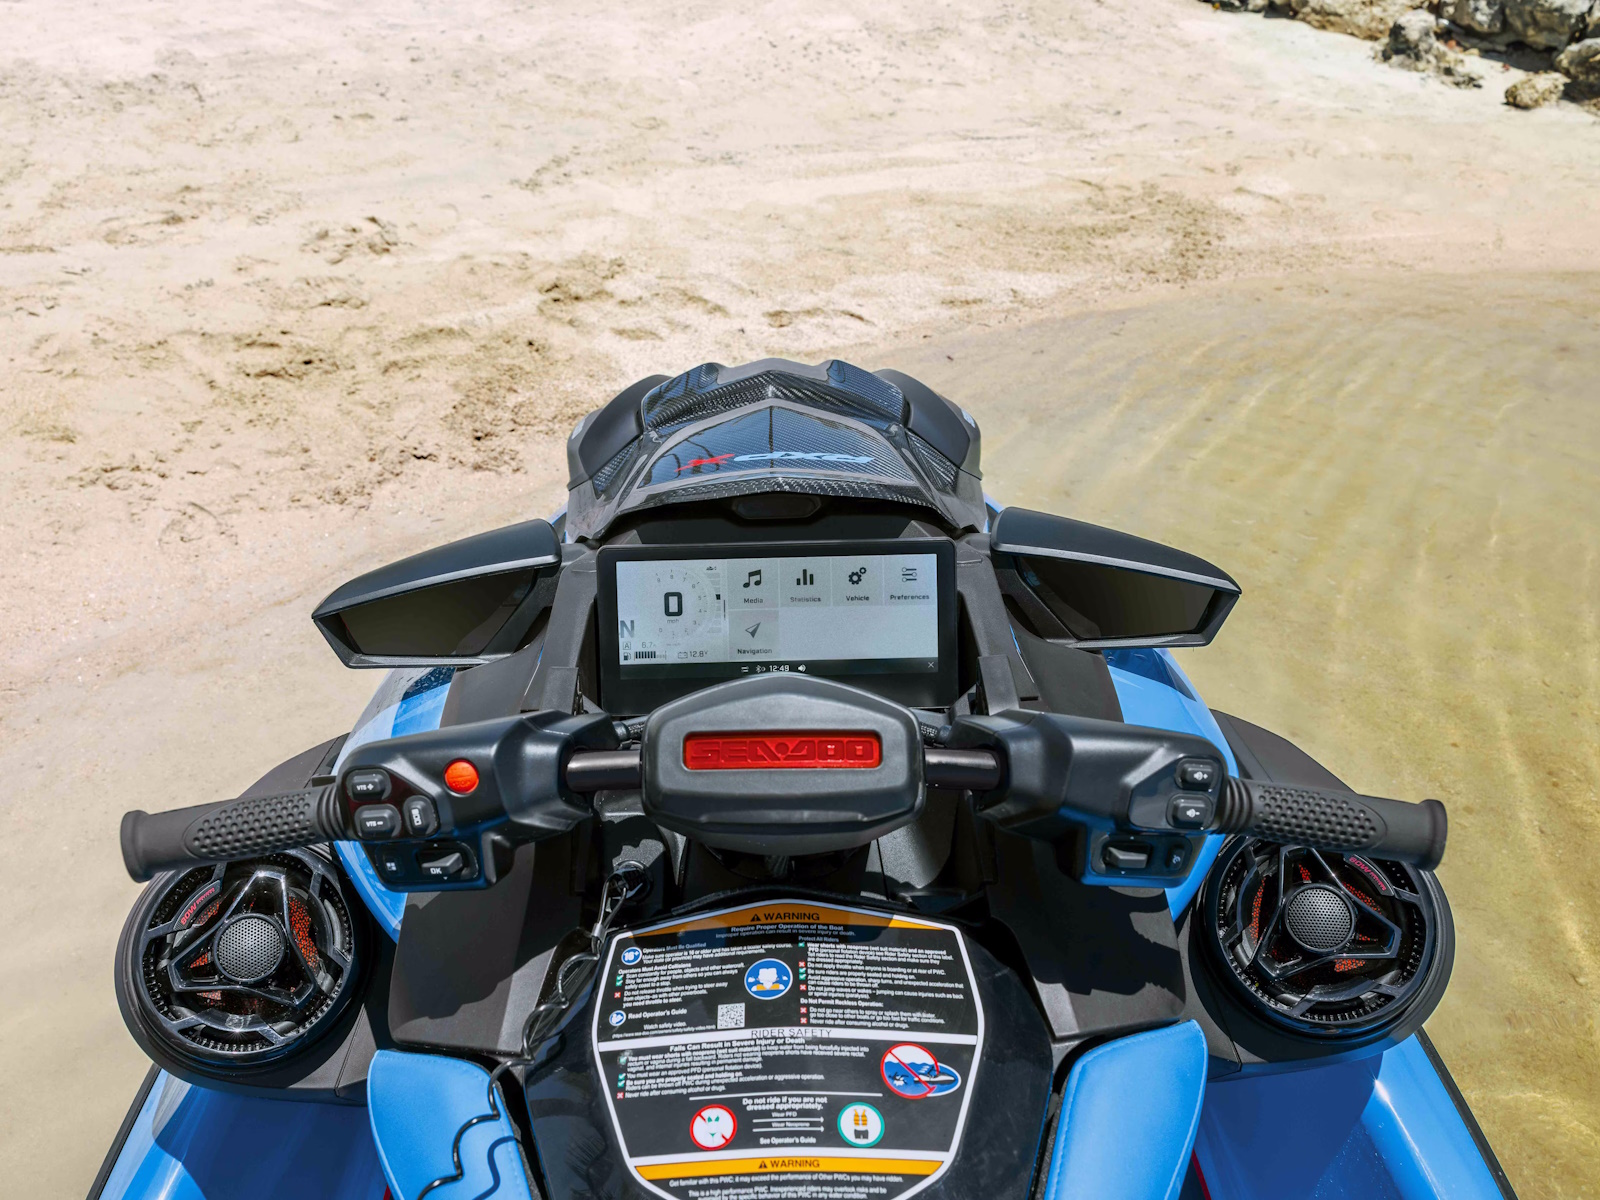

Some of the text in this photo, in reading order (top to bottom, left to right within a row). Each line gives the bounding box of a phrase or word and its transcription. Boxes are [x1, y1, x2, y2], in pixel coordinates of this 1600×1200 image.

[664, 592, 683, 617] 0
[619, 620, 634, 638] N
[643, 1010, 670, 1019] Operator's
[751, 1028, 832, 1038] RIDER SAFETY
[756, 1038, 775, 1046] Injury
[746, 1103, 774, 1111] dressed
[771, 1137, 799, 1145] Operator's
[800, 1136, 816, 1144] Guide
[770, 1160, 820, 1168] WARNING
